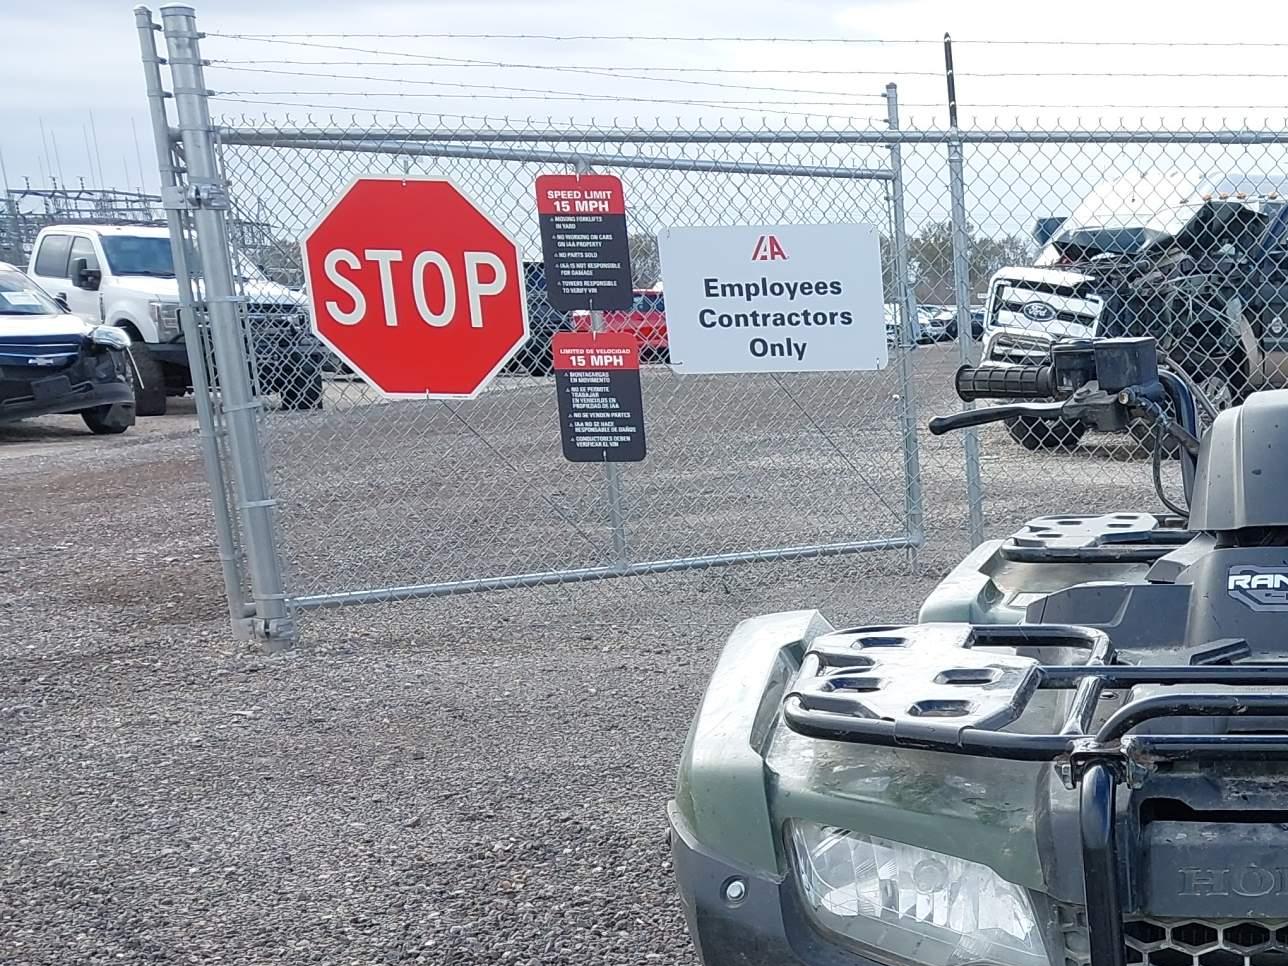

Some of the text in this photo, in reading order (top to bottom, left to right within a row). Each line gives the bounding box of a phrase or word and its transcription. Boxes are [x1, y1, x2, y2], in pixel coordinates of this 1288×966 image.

[547, 190, 612, 199] SPEED LIMIT
[553, 200, 609, 212] 15 MPH
[324, 248, 508, 328] STOP
[703, 277, 842, 301] Employees
[698, 308, 853, 328] Contractors
[749, 337, 807, 361] Only
[569, 355, 624, 366] 15 MPH
